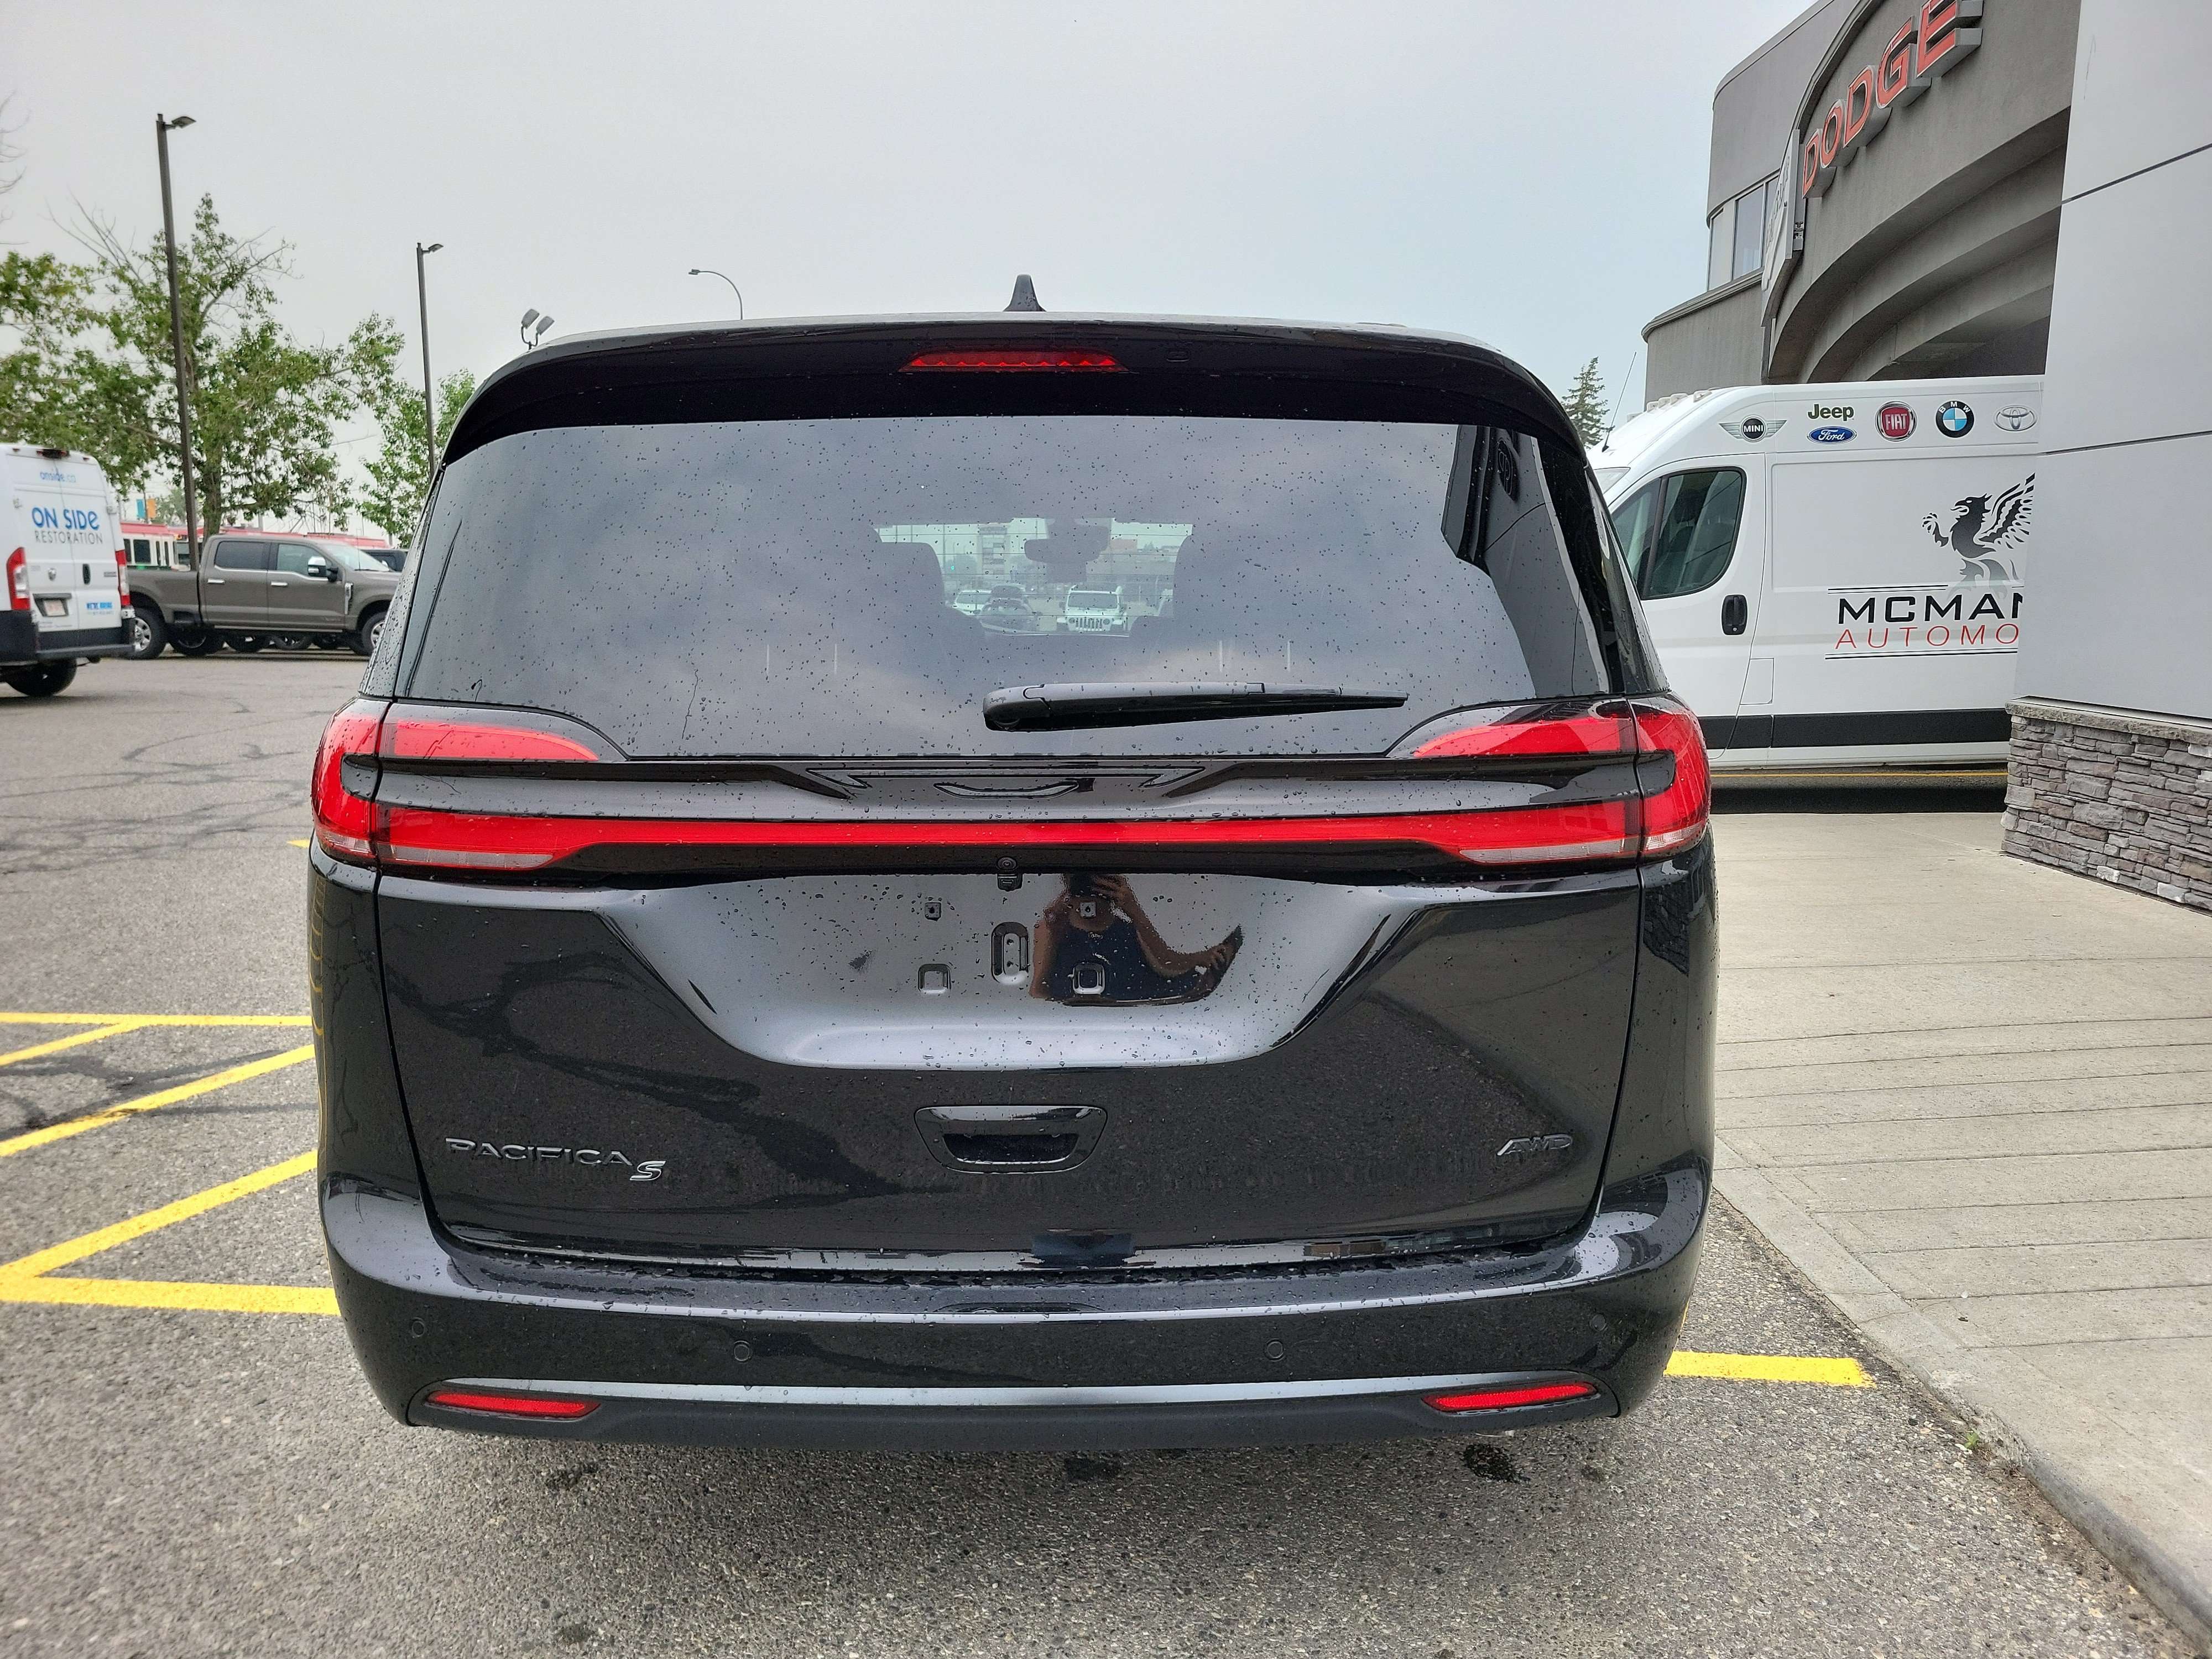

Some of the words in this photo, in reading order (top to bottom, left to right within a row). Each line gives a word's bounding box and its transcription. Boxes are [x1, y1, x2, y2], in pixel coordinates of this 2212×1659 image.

[1802, 0, 1958, 199] DODGE
[1808, 404, 1854, 421] Jeep
[1938, 401, 1970, 413] BMW
[1743, 425, 1764, 433] MINI
[1885, 413, 1907, 430] FIAT
[1818, 429, 1845, 441] Ford
[32, 507, 58, 528] ON
[34, 530, 103, 545] RESTORATION
[1835, 623, 2020, 650] AUTOMO
[1497, 1134, 1573, 1156] AWD
[446, 1137, 633, 1166] PACIFICA
[629, 1160, 666, 1181] S
